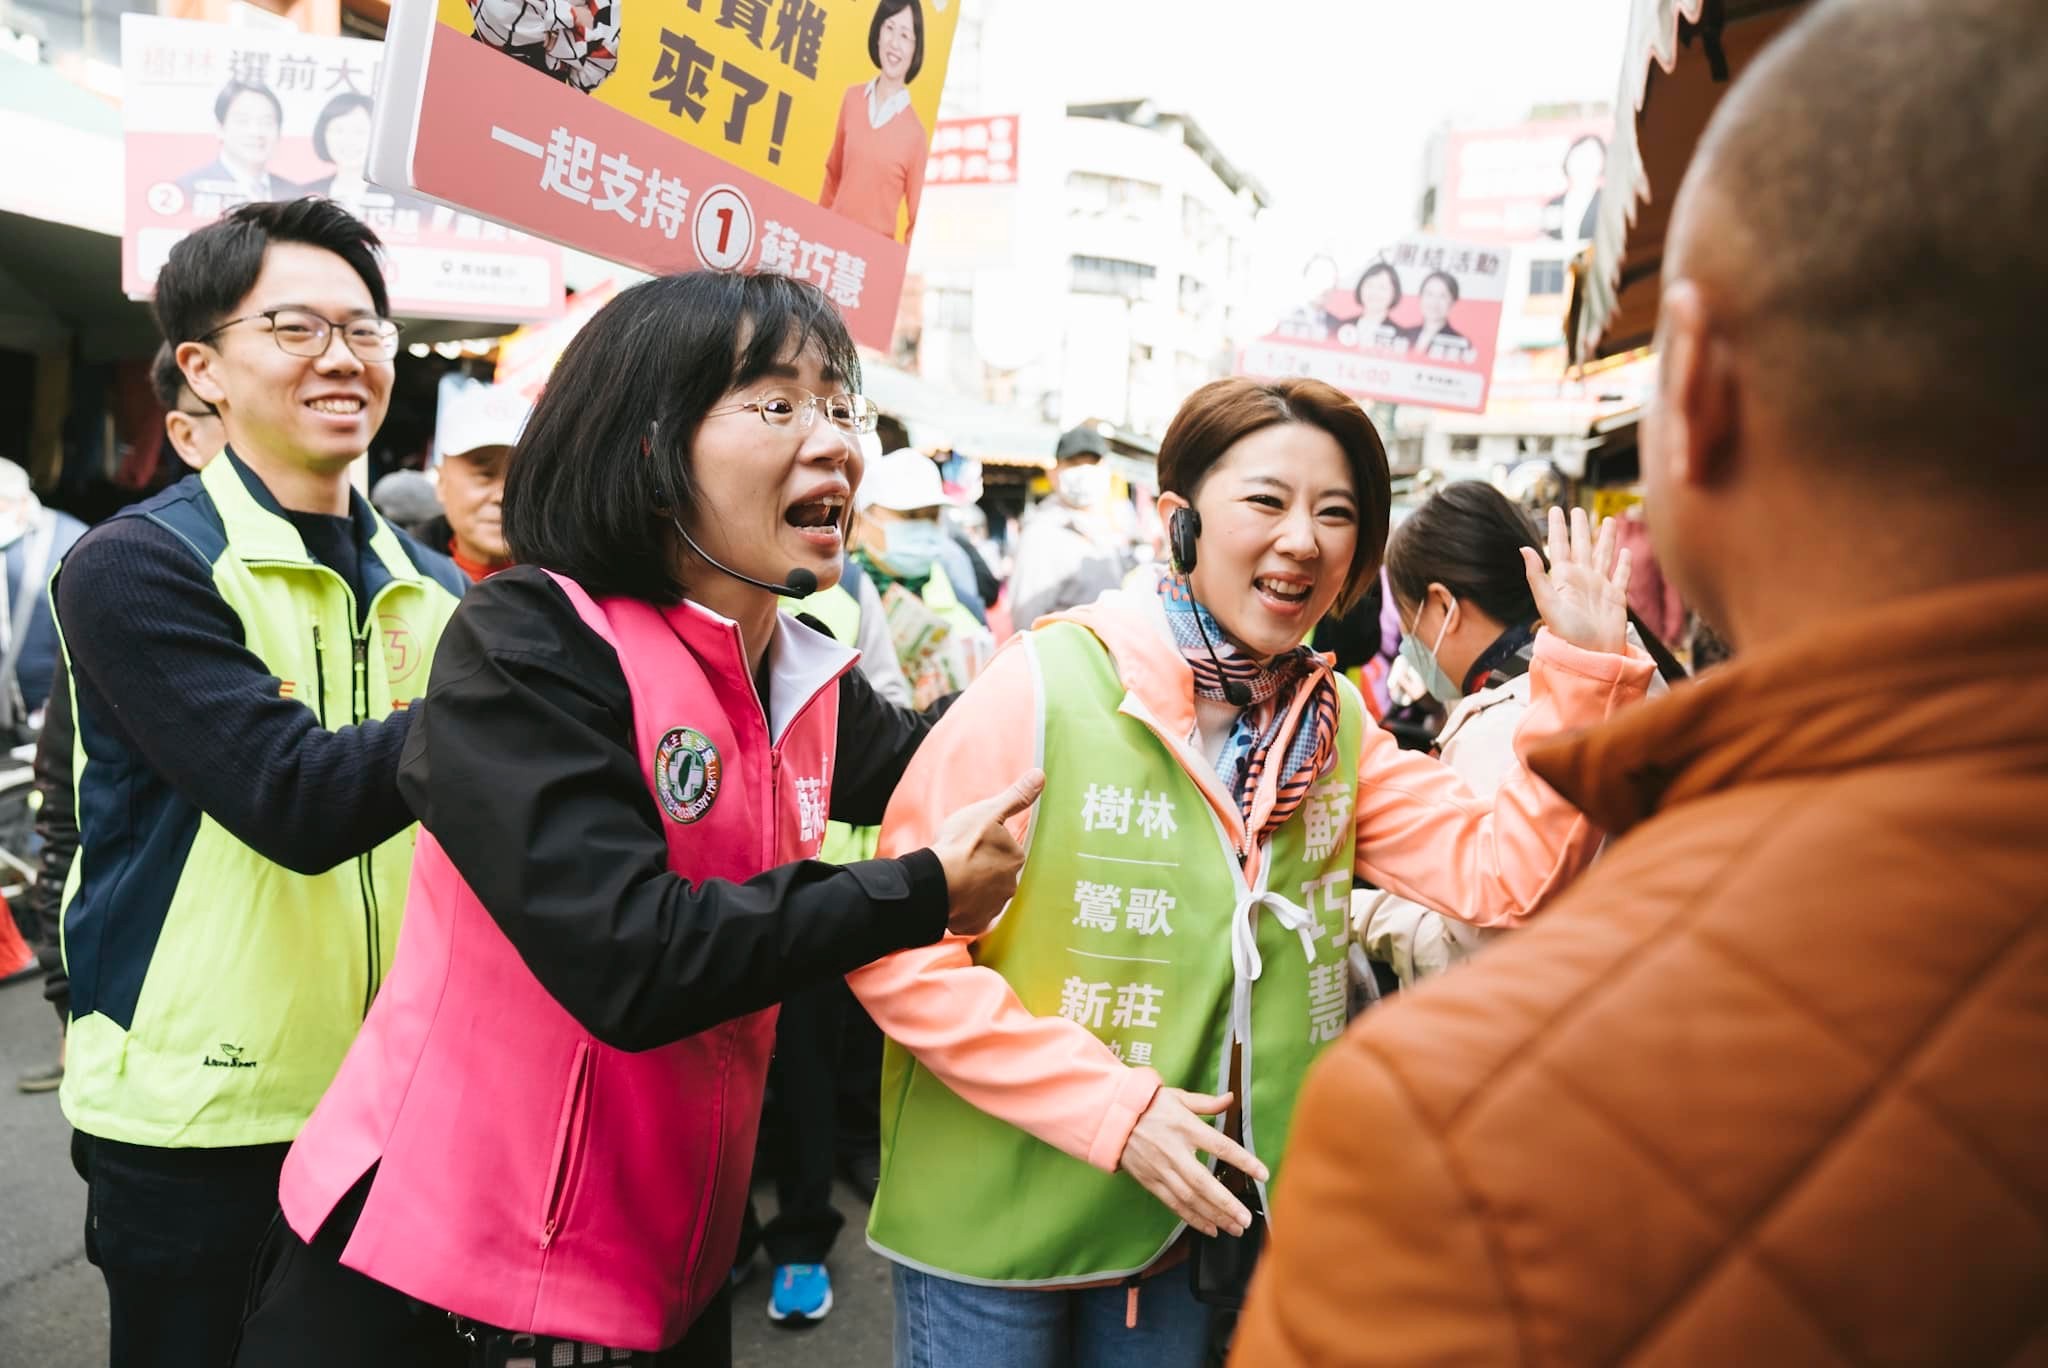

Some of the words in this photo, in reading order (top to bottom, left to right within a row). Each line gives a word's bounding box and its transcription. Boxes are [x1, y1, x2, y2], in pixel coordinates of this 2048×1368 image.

[228, 49, 382, 98] 選前大
[491, 124, 691, 240] 一起支持
[1082, 783, 1178, 839] 樹林
[1072, 880, 1177, 937] 鶯歌
[1059, 976, 1164, 1029] 新莊
